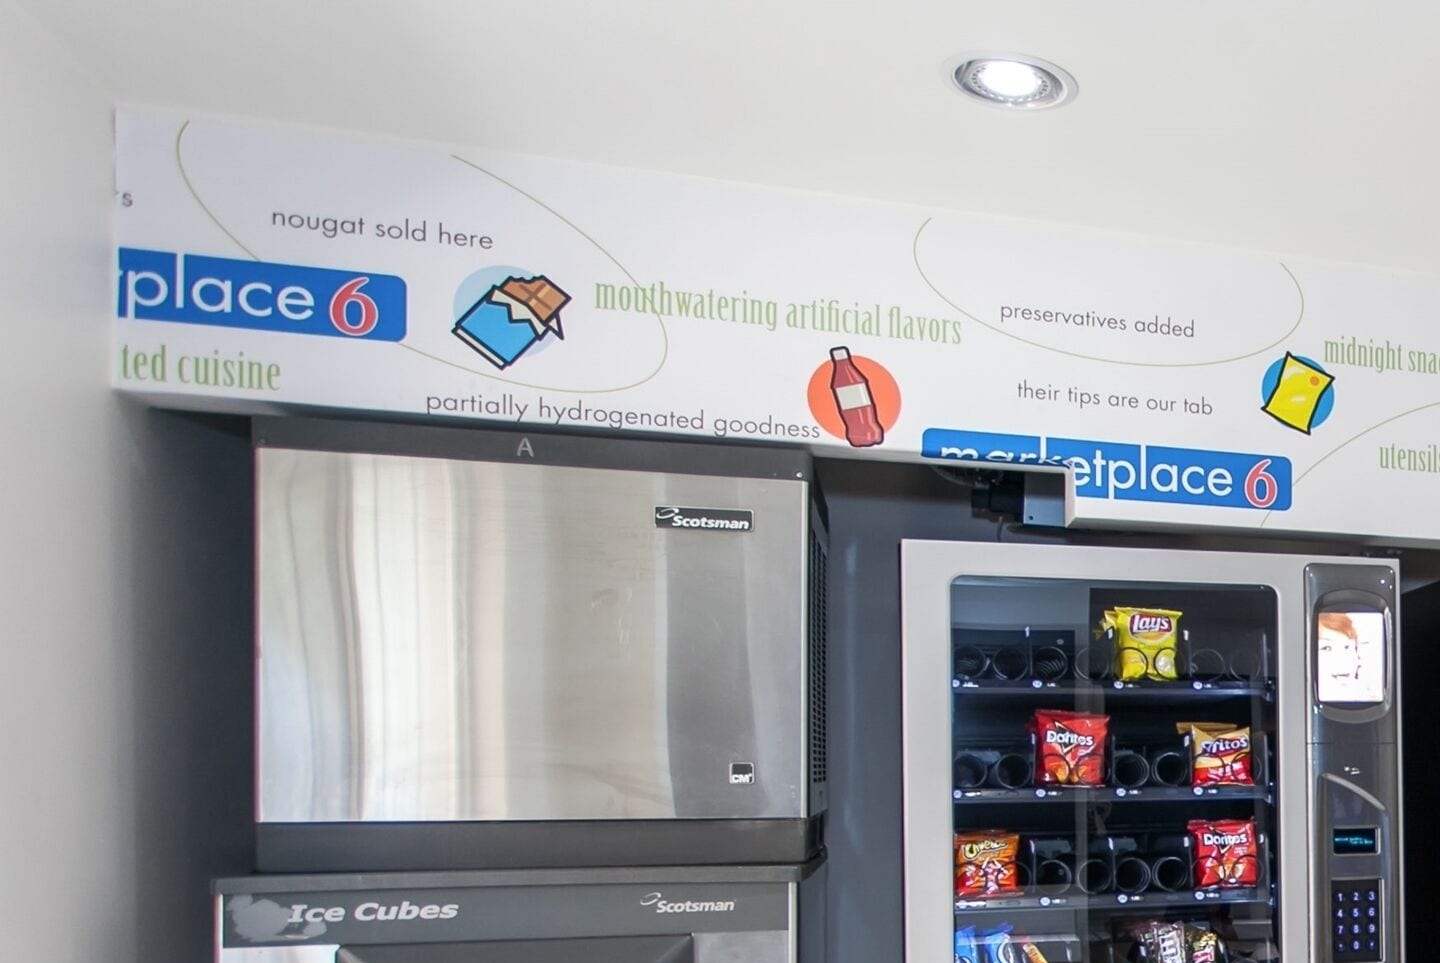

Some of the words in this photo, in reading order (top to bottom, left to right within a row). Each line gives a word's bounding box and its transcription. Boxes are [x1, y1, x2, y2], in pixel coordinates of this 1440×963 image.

[272, 210, 365, 239] nougat
[376, 219, 427, 243] sold
[439, 222, 493, 250] here
[118, 253, 315, 320] place
[328, 277, 379, 336] 6
[595, 281, 777, 331] mouthwatering
[786, 299, 880, 338] artificial
[888, 306, 962, 345] flavors
[1000, 303, 1127, 333] preservatives
[1134, 315, 1194, 338] added
[178, 352, 281, 391] cuisine
[1324, 336, 1403, 373] midnight
[1017, 380, 1060, 403] their
[1068, 386, 1101, 408] tips
[1107, 390, 1139, 410] are
[1146, 393, 1176, 413] our
[1183, 393, 1214, 416] tab
[426, 394, 529, 423] partially
[538, 396, 705, 430] hydrogenated
[713, 412, 821, 439] goodness
[516, 437, 535, 458] A
[1244, 457, 1279, 508] 6
[672, 515, 750, 531] Scotsman
[1046, 731, 1094, 747] Doritos
[1203, 833, 1248, 846] Doritos
[287, 903, 346, 924] Ice
[354, 901, 459, 922] Cubes
[656, 899, 735, 913] Scotsman
